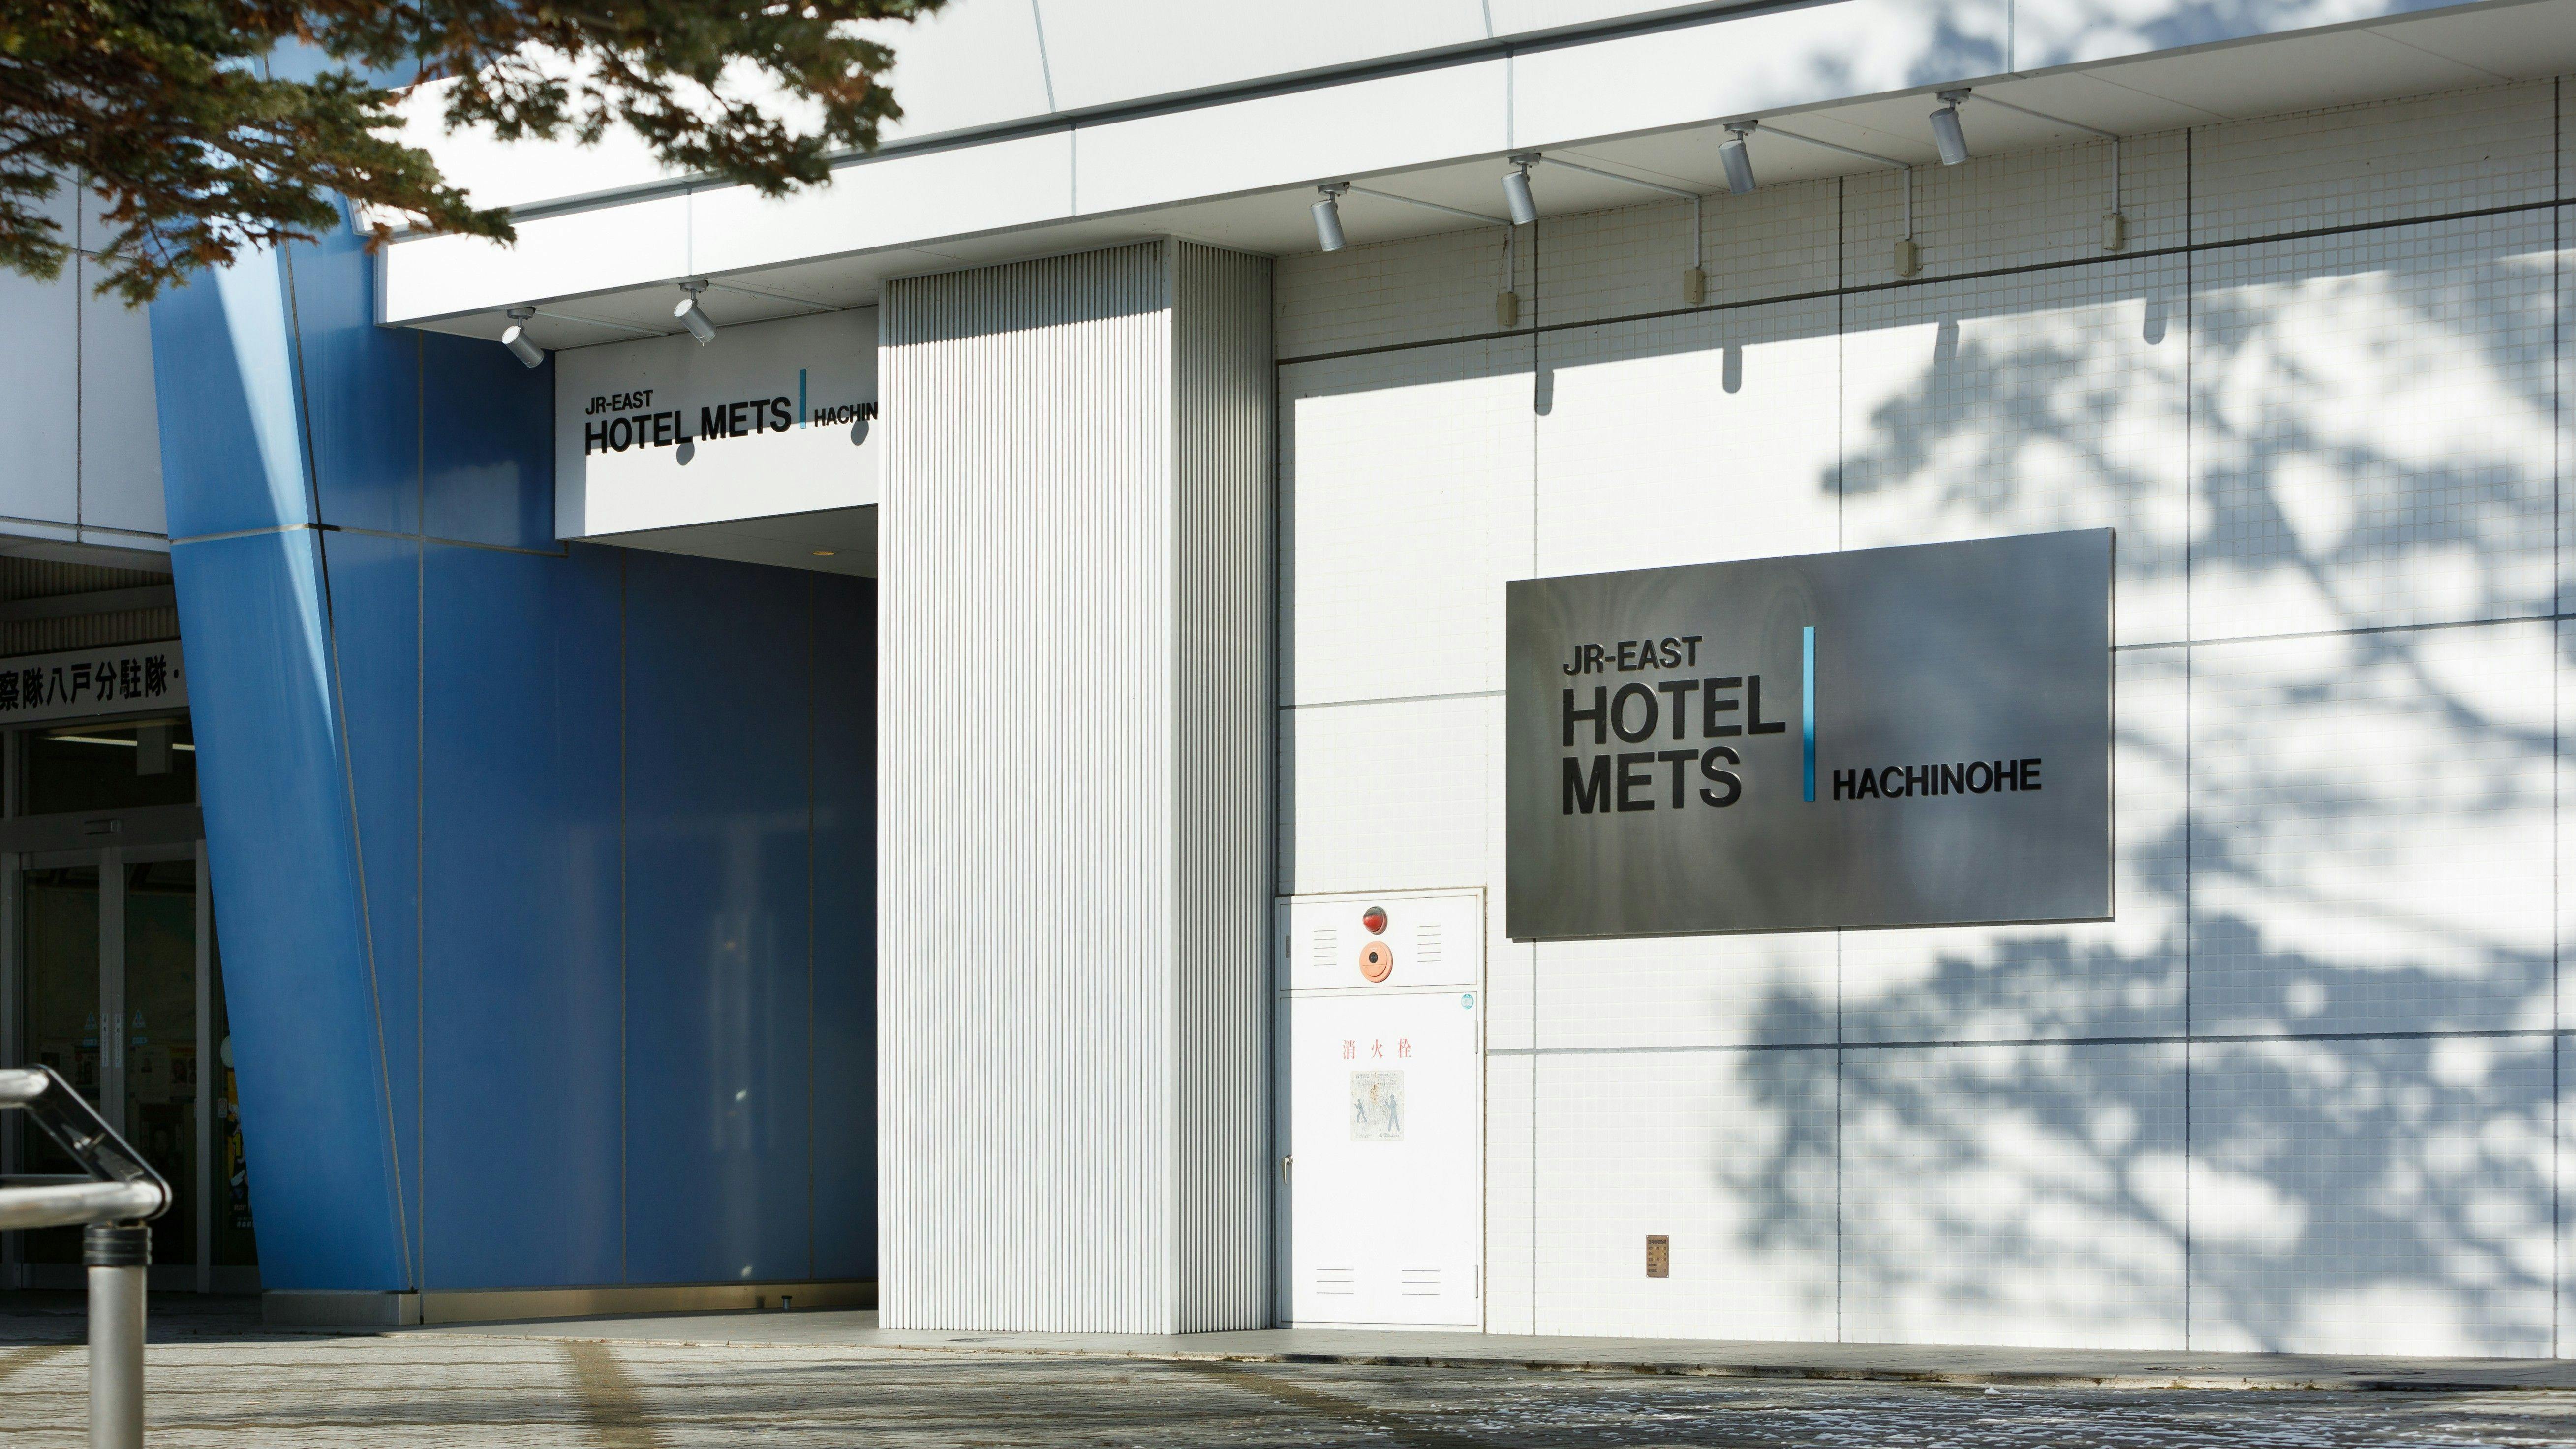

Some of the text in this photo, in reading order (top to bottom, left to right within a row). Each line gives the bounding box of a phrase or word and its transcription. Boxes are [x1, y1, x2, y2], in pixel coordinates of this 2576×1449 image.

[585, 389, 653, 415] JR-EAST
[585, 397, 791, 455] HOTEL METS
[1563, 636, 1703, 676] JR-EAST
[1563, 675, 1786, 747] HOTEL
[1563, 745, 1741, 815] METS
[1834, 758, 2042, 801] HACHINOHE
[1343, 1038, 1412, 1060] 消火栓
